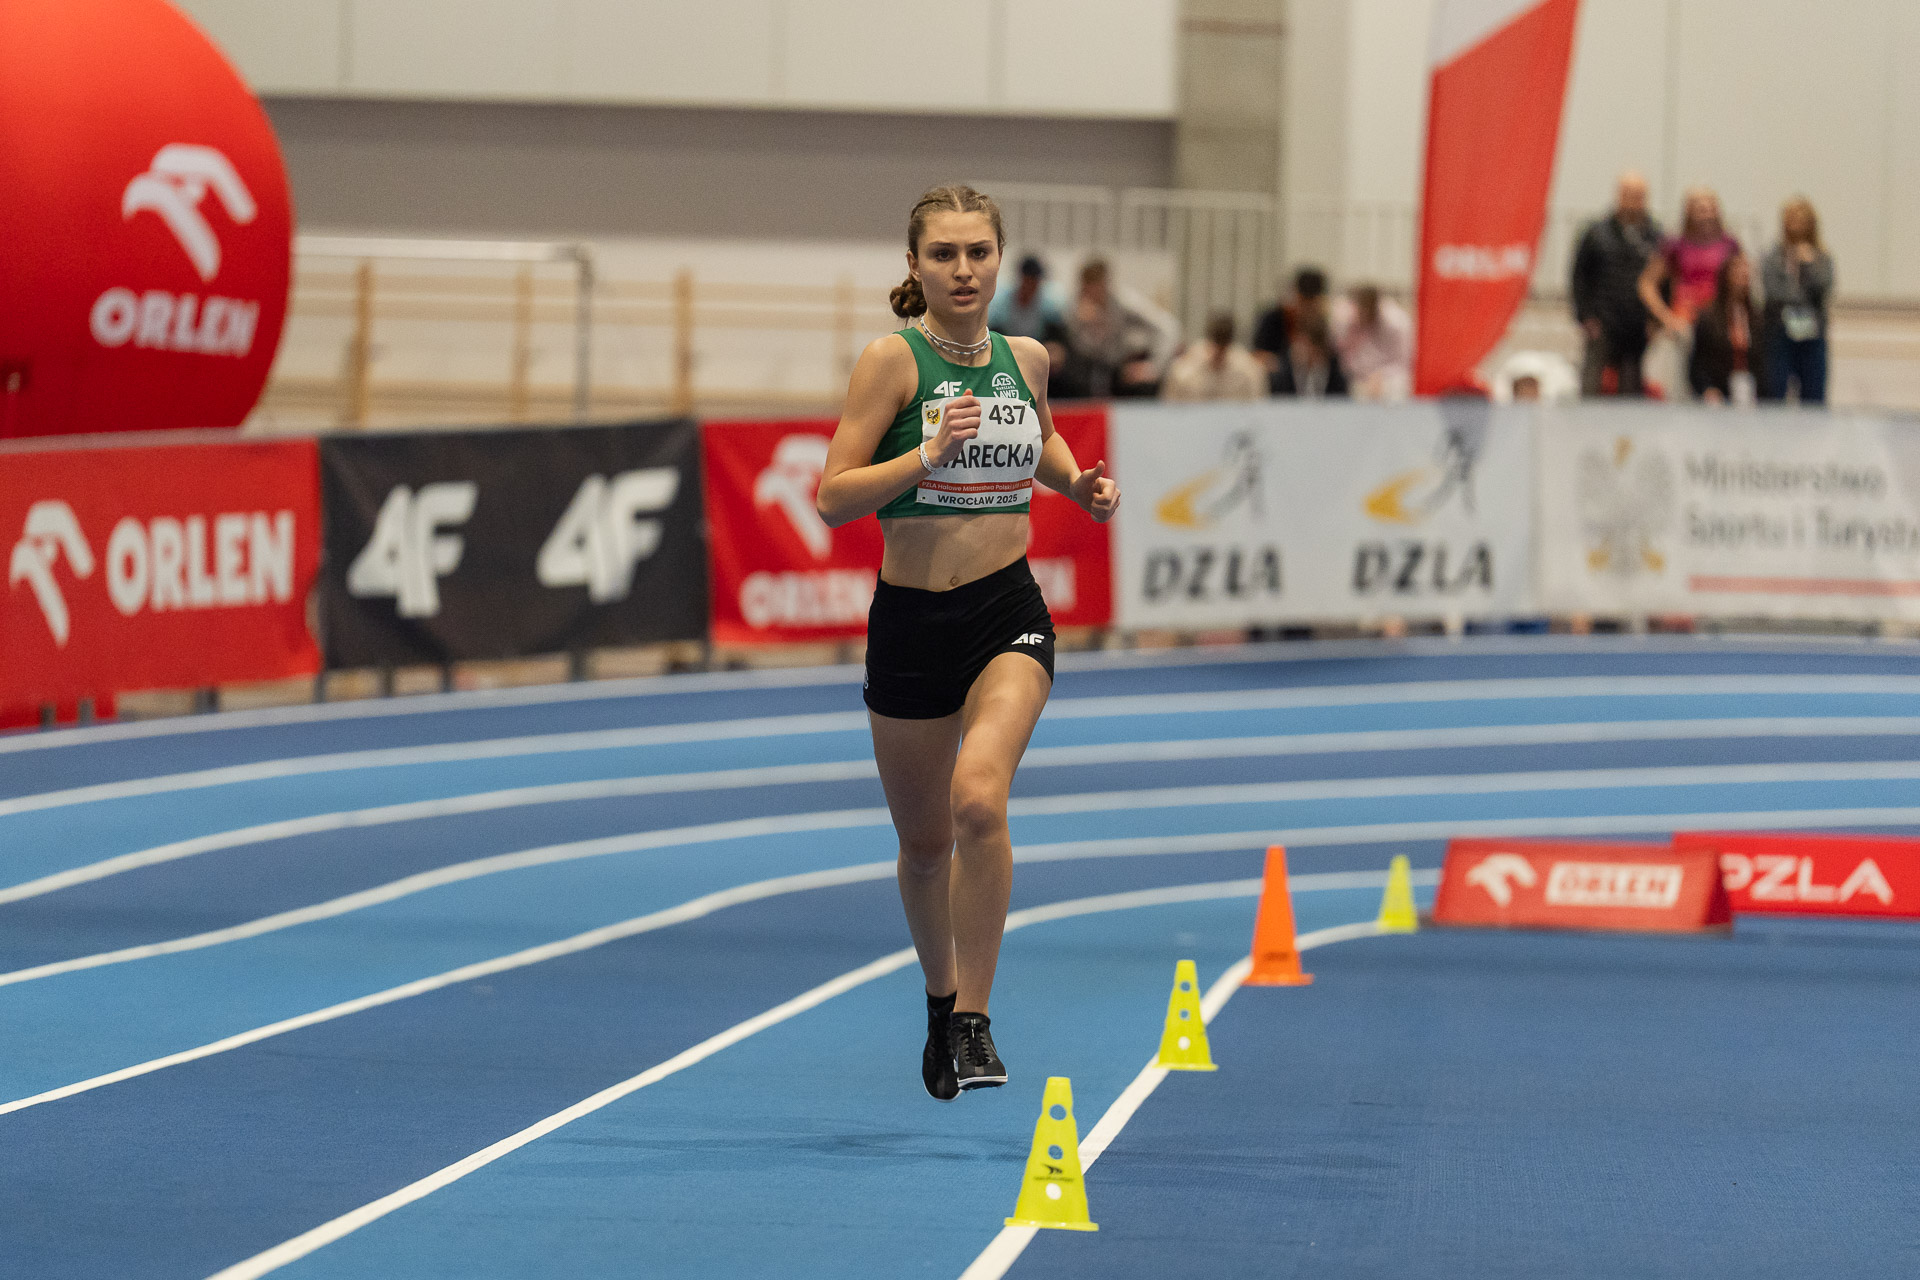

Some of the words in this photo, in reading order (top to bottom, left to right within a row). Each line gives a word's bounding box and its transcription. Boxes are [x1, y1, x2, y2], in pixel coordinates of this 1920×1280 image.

[90, 287, 260, 357] ORLEN
[933, 380, 962, 397] 4F
[989, 404, 1026, 425] 437
[942, 443, 1034, 469] ARECKA
[937, 494, 994, 506] WROCŁAW
[996, 493, 1018, 505] 2025
[106, 510, 295, 615] ORLEN
[347, 480, 479, 618] 4F
[535, 467, 681, 604] 4F
[1143, 544, 1281, 602] DZLA
[1352, 539, 1493, 596] DZLA
[1719, 851, 1894, 905] PZLA
